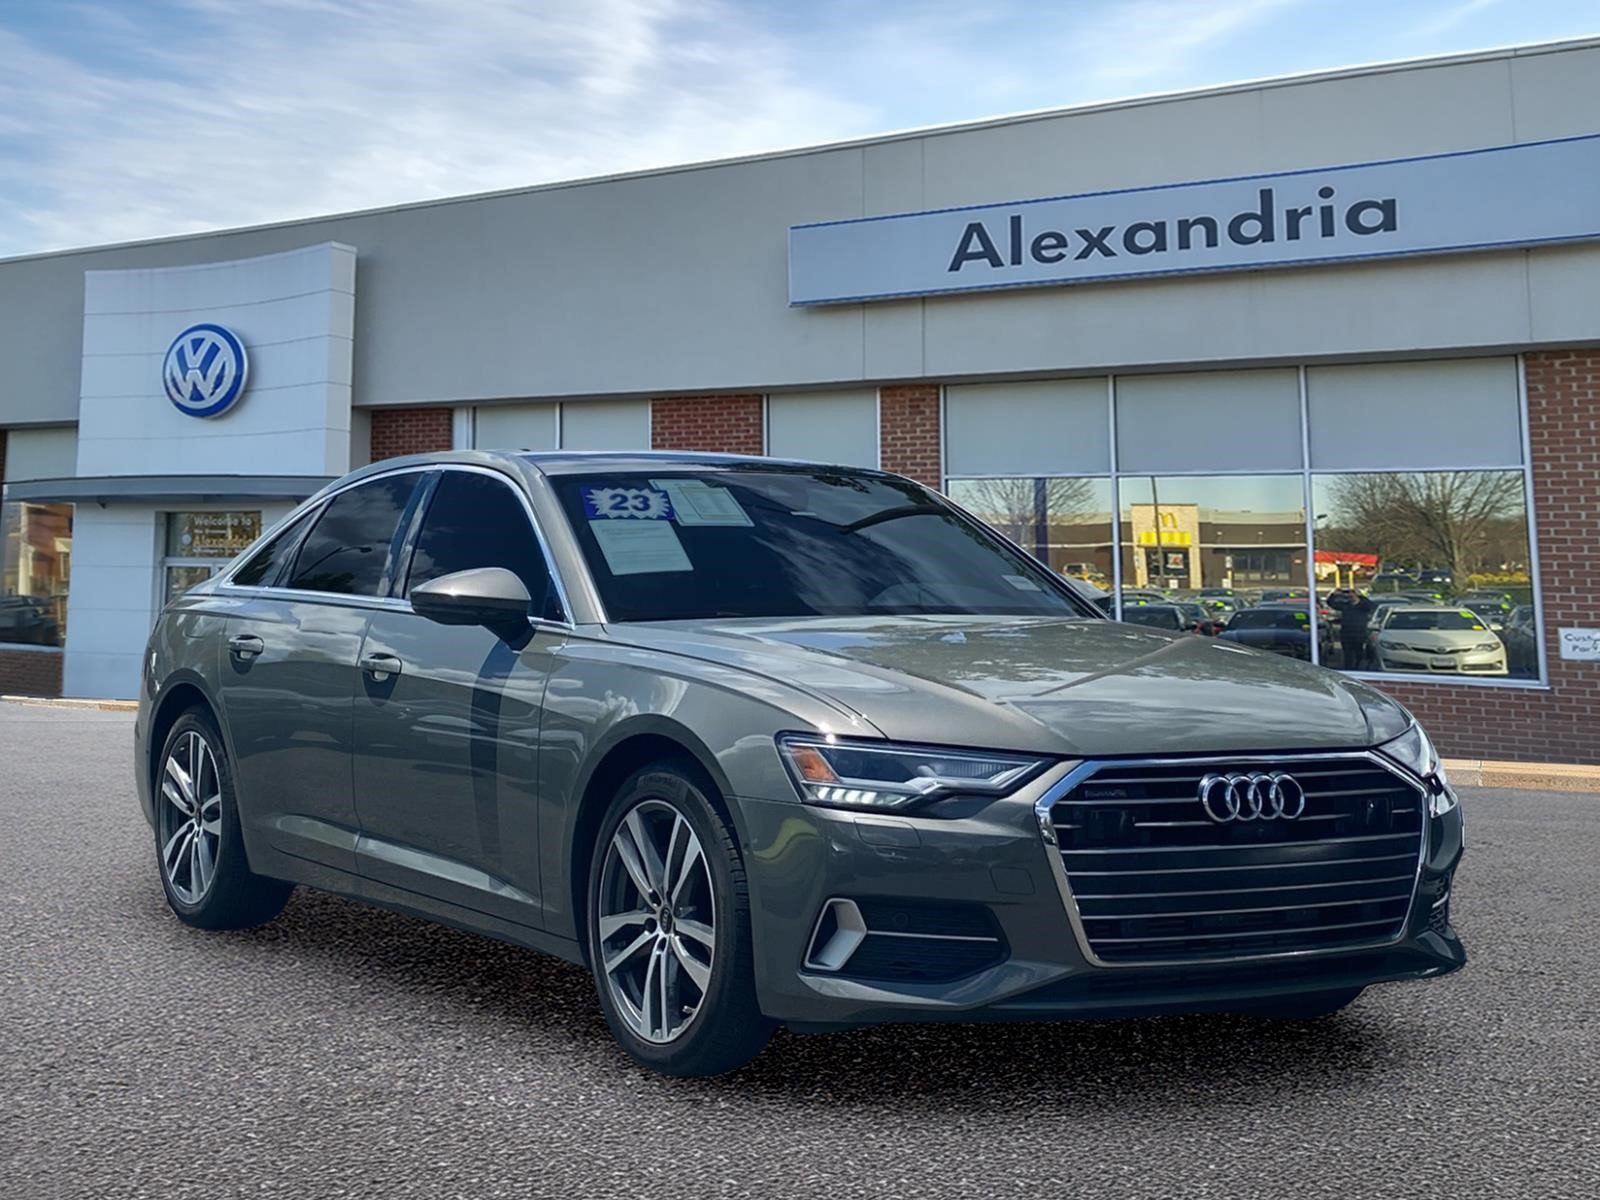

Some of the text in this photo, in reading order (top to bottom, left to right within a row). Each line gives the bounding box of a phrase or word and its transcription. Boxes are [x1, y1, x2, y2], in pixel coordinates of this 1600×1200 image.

[947, 185, 1398, 272] Alexandria
[165, 327, 242, 412] VW
[608, 493, 651, 511] 23
[1564, 633, 1592, 641] Cust
